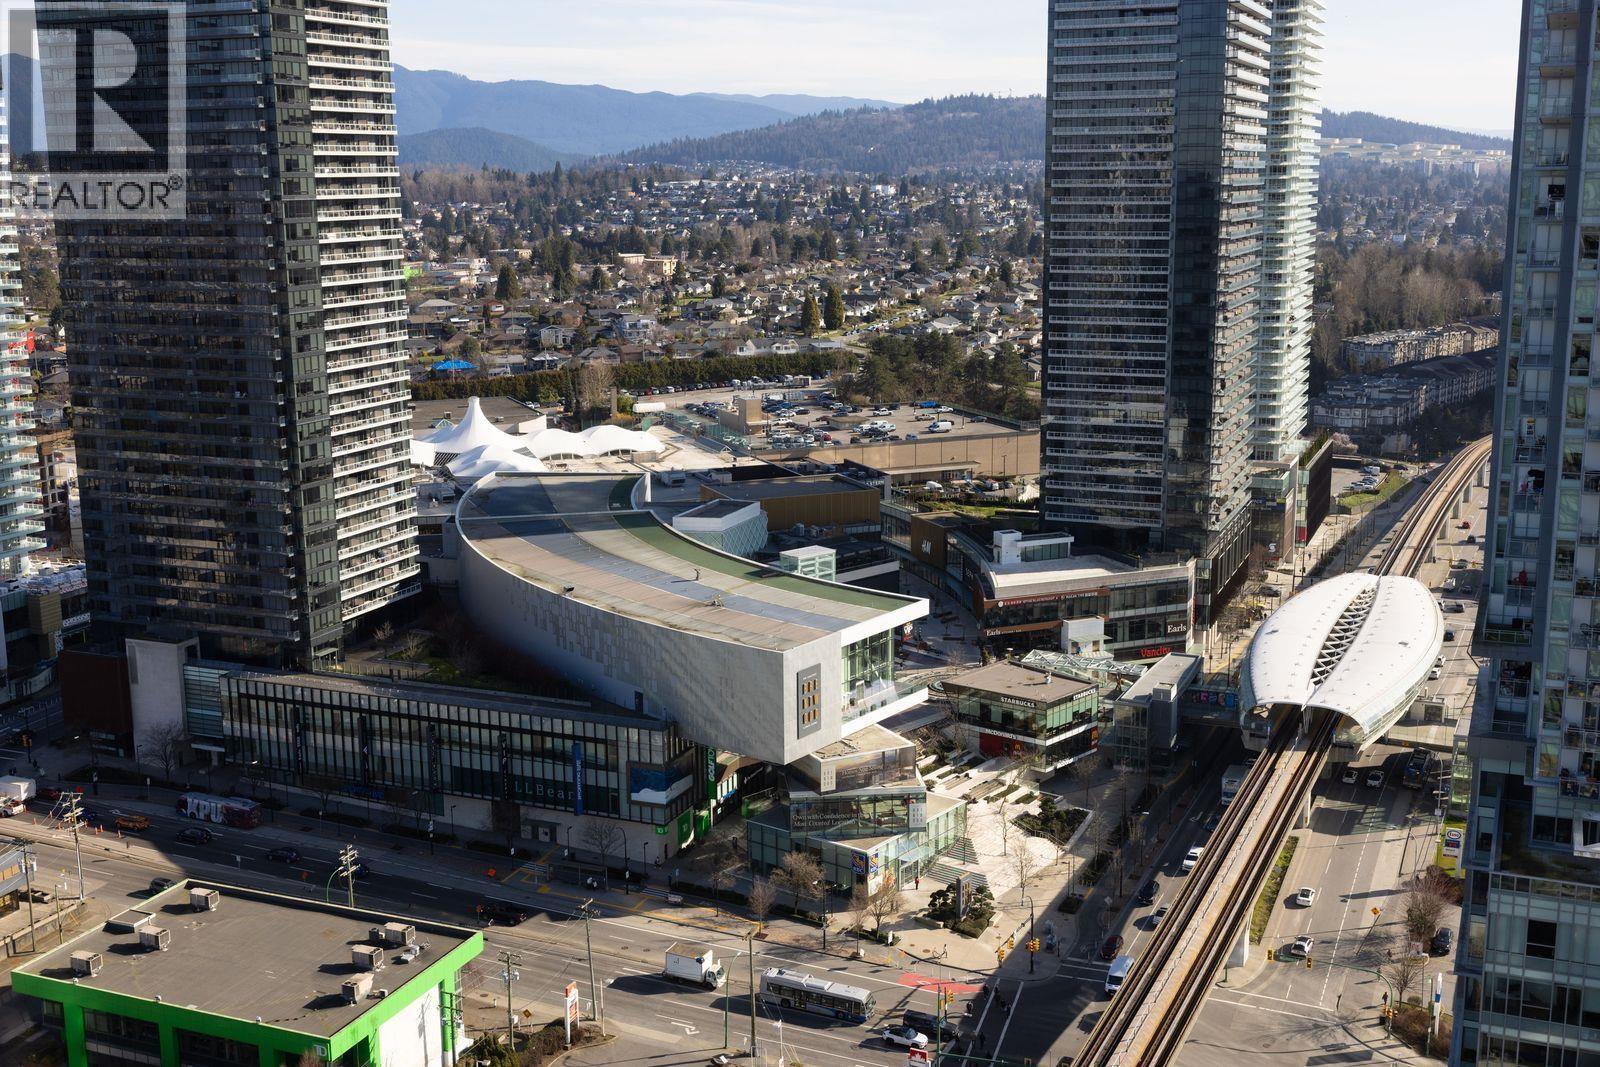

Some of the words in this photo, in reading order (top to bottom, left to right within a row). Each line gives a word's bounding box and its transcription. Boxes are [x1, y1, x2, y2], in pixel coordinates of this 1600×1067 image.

[1167, 623, 1187, 633] Earls
[1140, 645, 1170, 657] Vancity
[1073, 688, 1096, 701] STARBUCKS
[1000, 697, 1035, 708] STARBUCKS
[313, 1044, 328, 1057] TD
